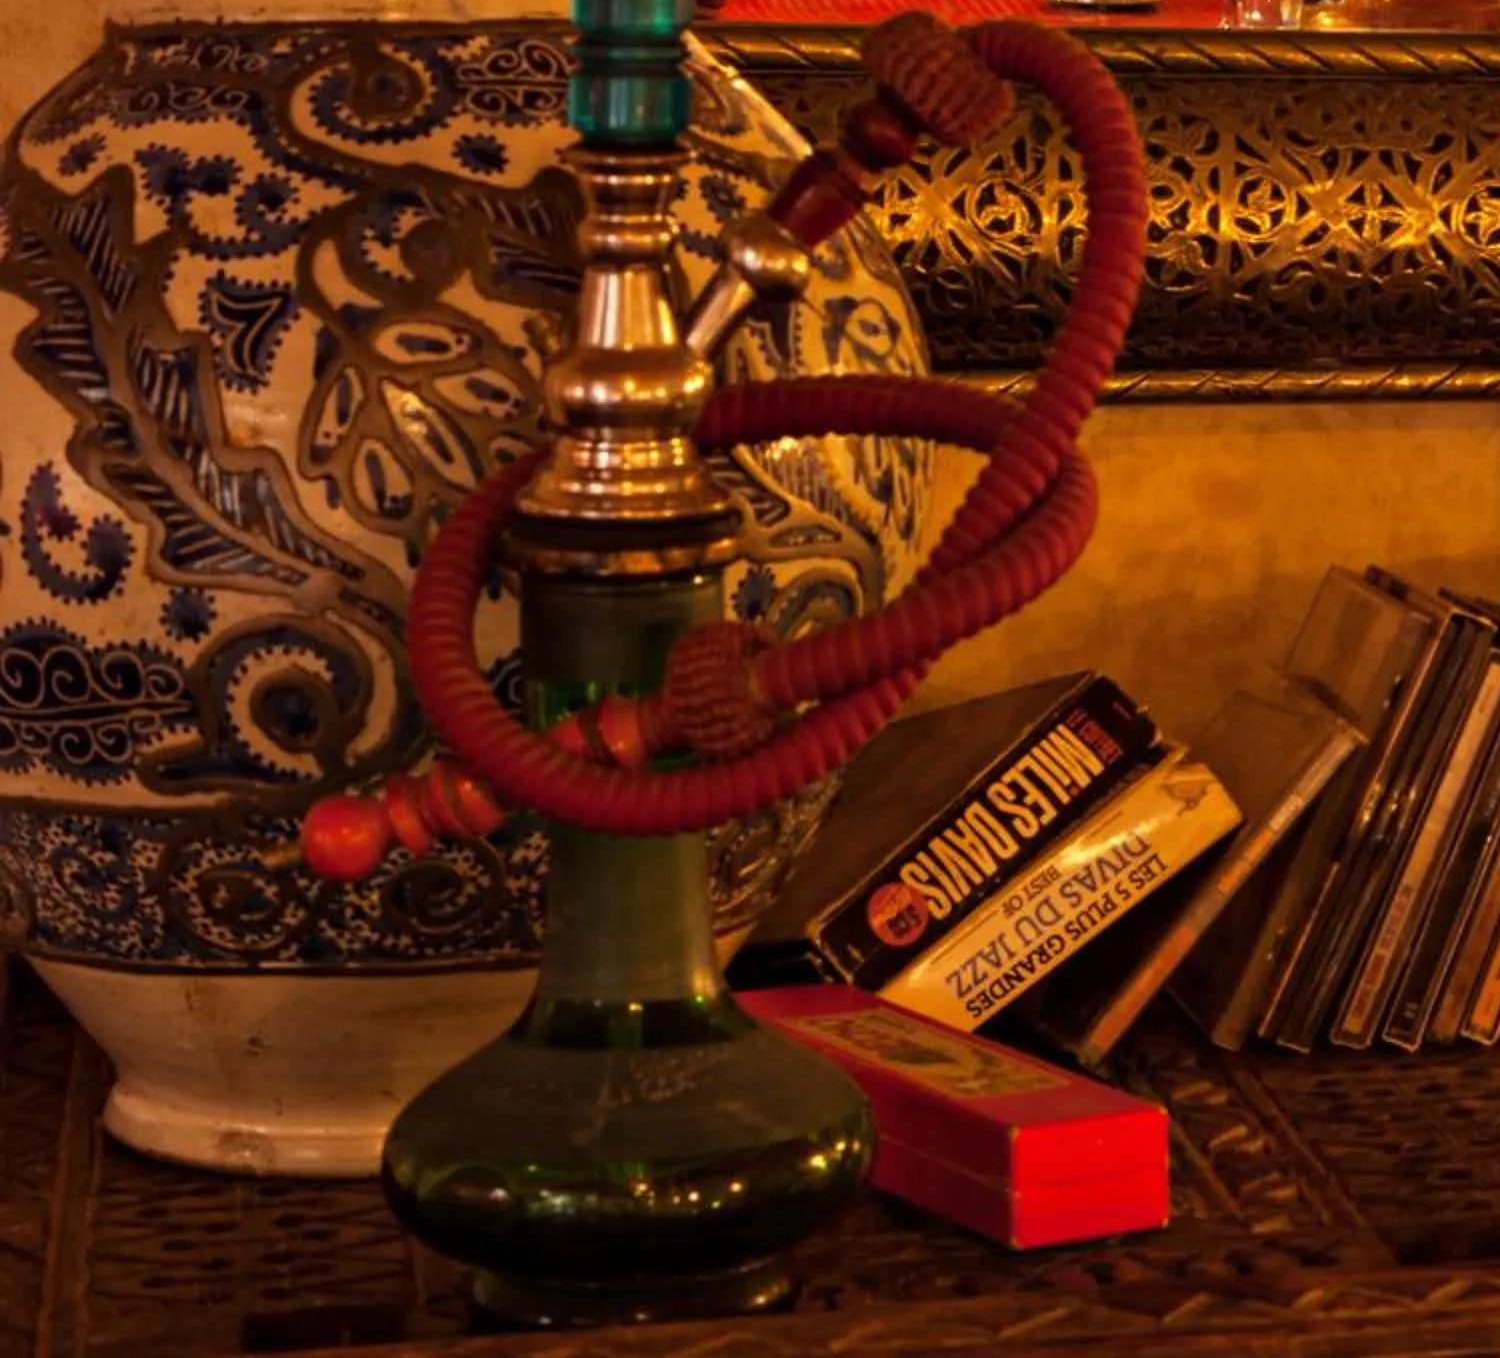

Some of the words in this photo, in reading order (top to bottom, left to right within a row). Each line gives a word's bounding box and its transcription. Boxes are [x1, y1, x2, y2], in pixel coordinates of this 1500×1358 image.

[900, 802, 1020, 920] DAVIS
[1023, 865, 1062, 901] BEST
[1059, 832, 1152, 910] DIVAS
[1128, 853, 1168, 891] LES
[1002, 895, 1024, 917] OF
[1114, 882, 1132, 902] 5
[1014, 896, 1065, 948] DU
[1064, 894, 1118, 941] PLUS
[945, 932, 1017, 999] JAZZ
[964, 934, 1066, 1018] GRANDES
